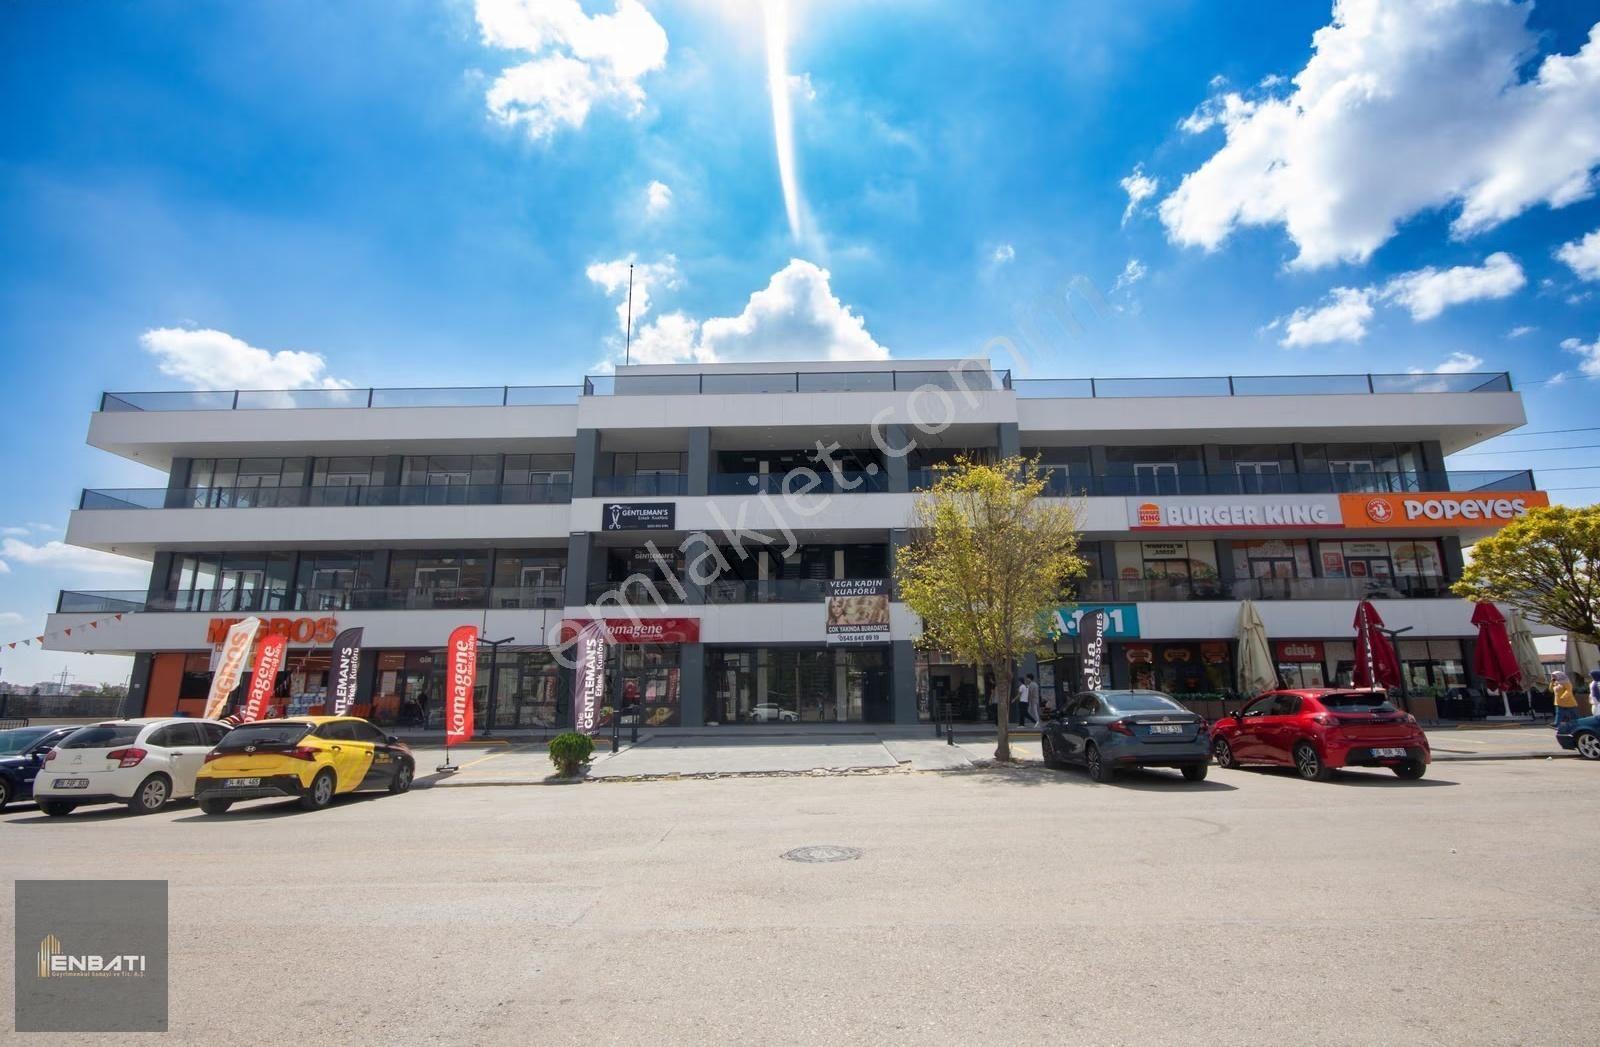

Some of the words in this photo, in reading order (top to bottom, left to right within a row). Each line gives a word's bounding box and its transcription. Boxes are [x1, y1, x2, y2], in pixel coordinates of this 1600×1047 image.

[1166, 504, 1260, 525] BURGER
[1264, 504, 1328, 524] KING
[830, 580, 852, 588] VEGA
[855, 579, 882, 587] KADIN
[207, 617, 337, 643] MGROS
[1095, 613, 1103, 691] ACCESSORIES
[347, 684, 355, 705] Erkek
[447, 640, 471, 735] komagene
[584, 639, 597, 729] GENTLEMAN'S
[595, 674, 603, 697] Erkek
